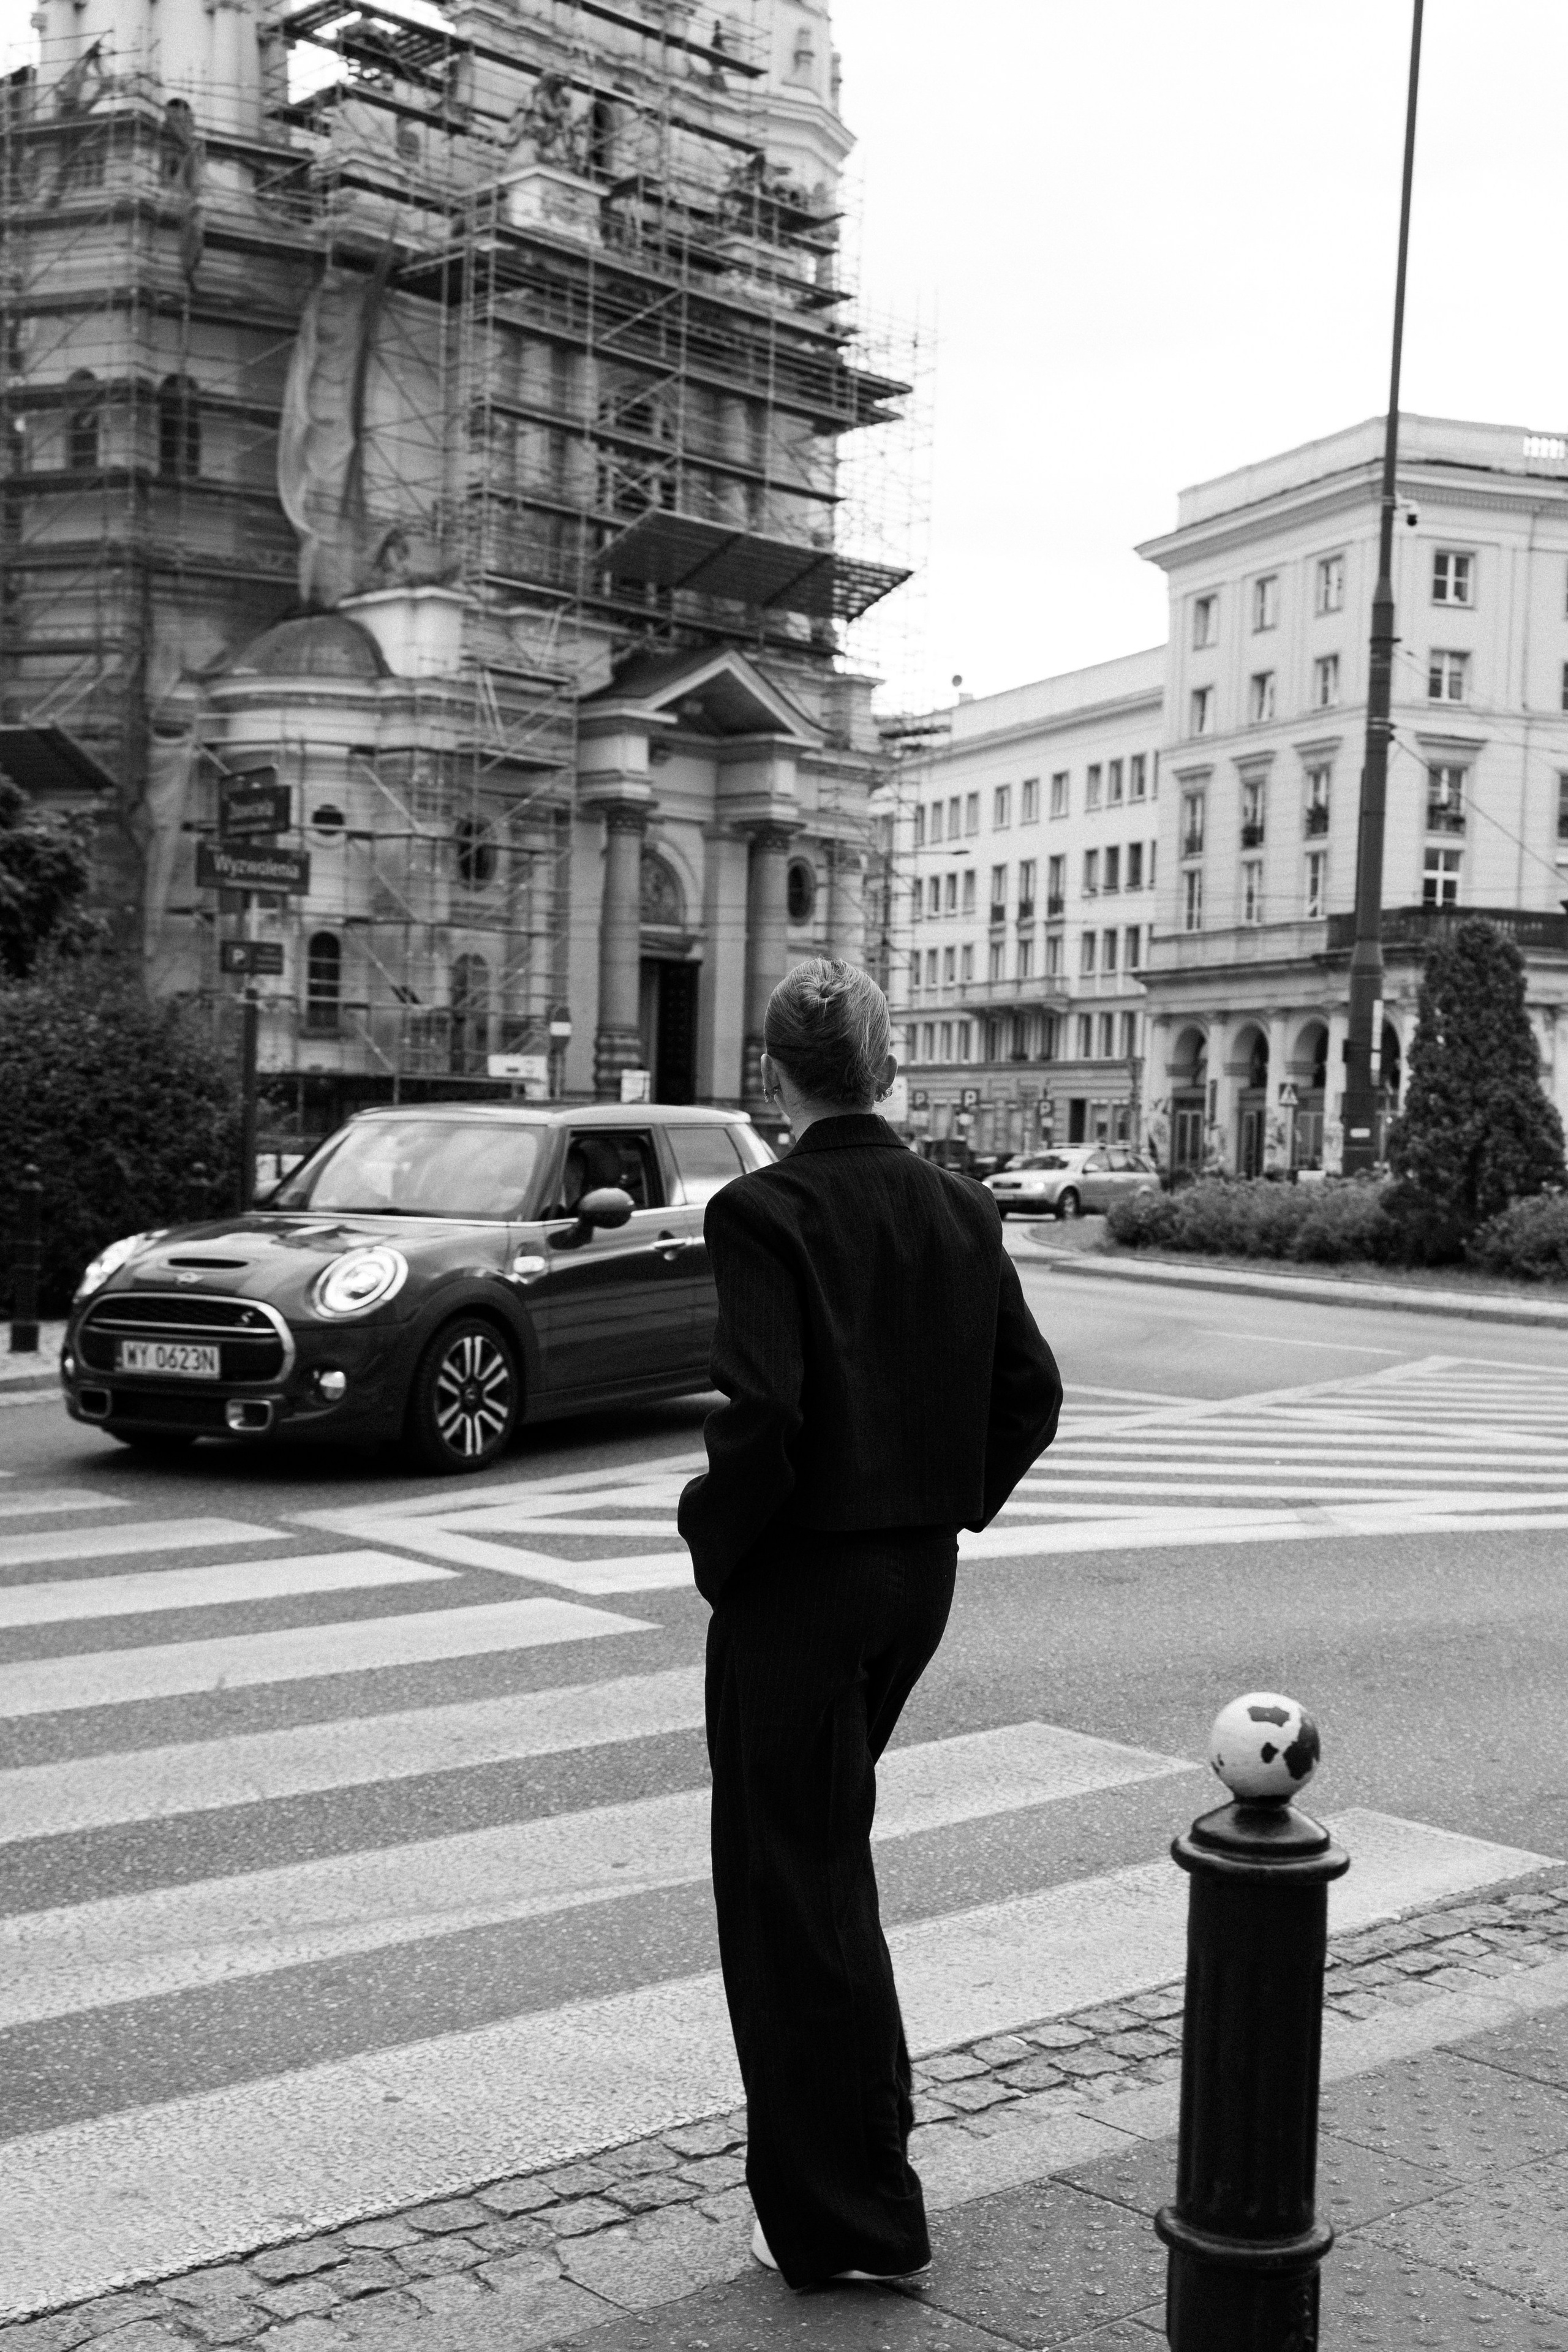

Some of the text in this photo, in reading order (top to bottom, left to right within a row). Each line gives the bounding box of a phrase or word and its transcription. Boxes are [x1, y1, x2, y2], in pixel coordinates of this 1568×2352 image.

[213, 854, 300, 879] Wyzwolenia
[232, 948, 246, 964] P
[915, 1091, 925, 1105] P
[964, 1090, 977, 1107] P
[1039, 1101, 1050, 1115] P
[126, 1344, 215, 1371] WY 0623N
